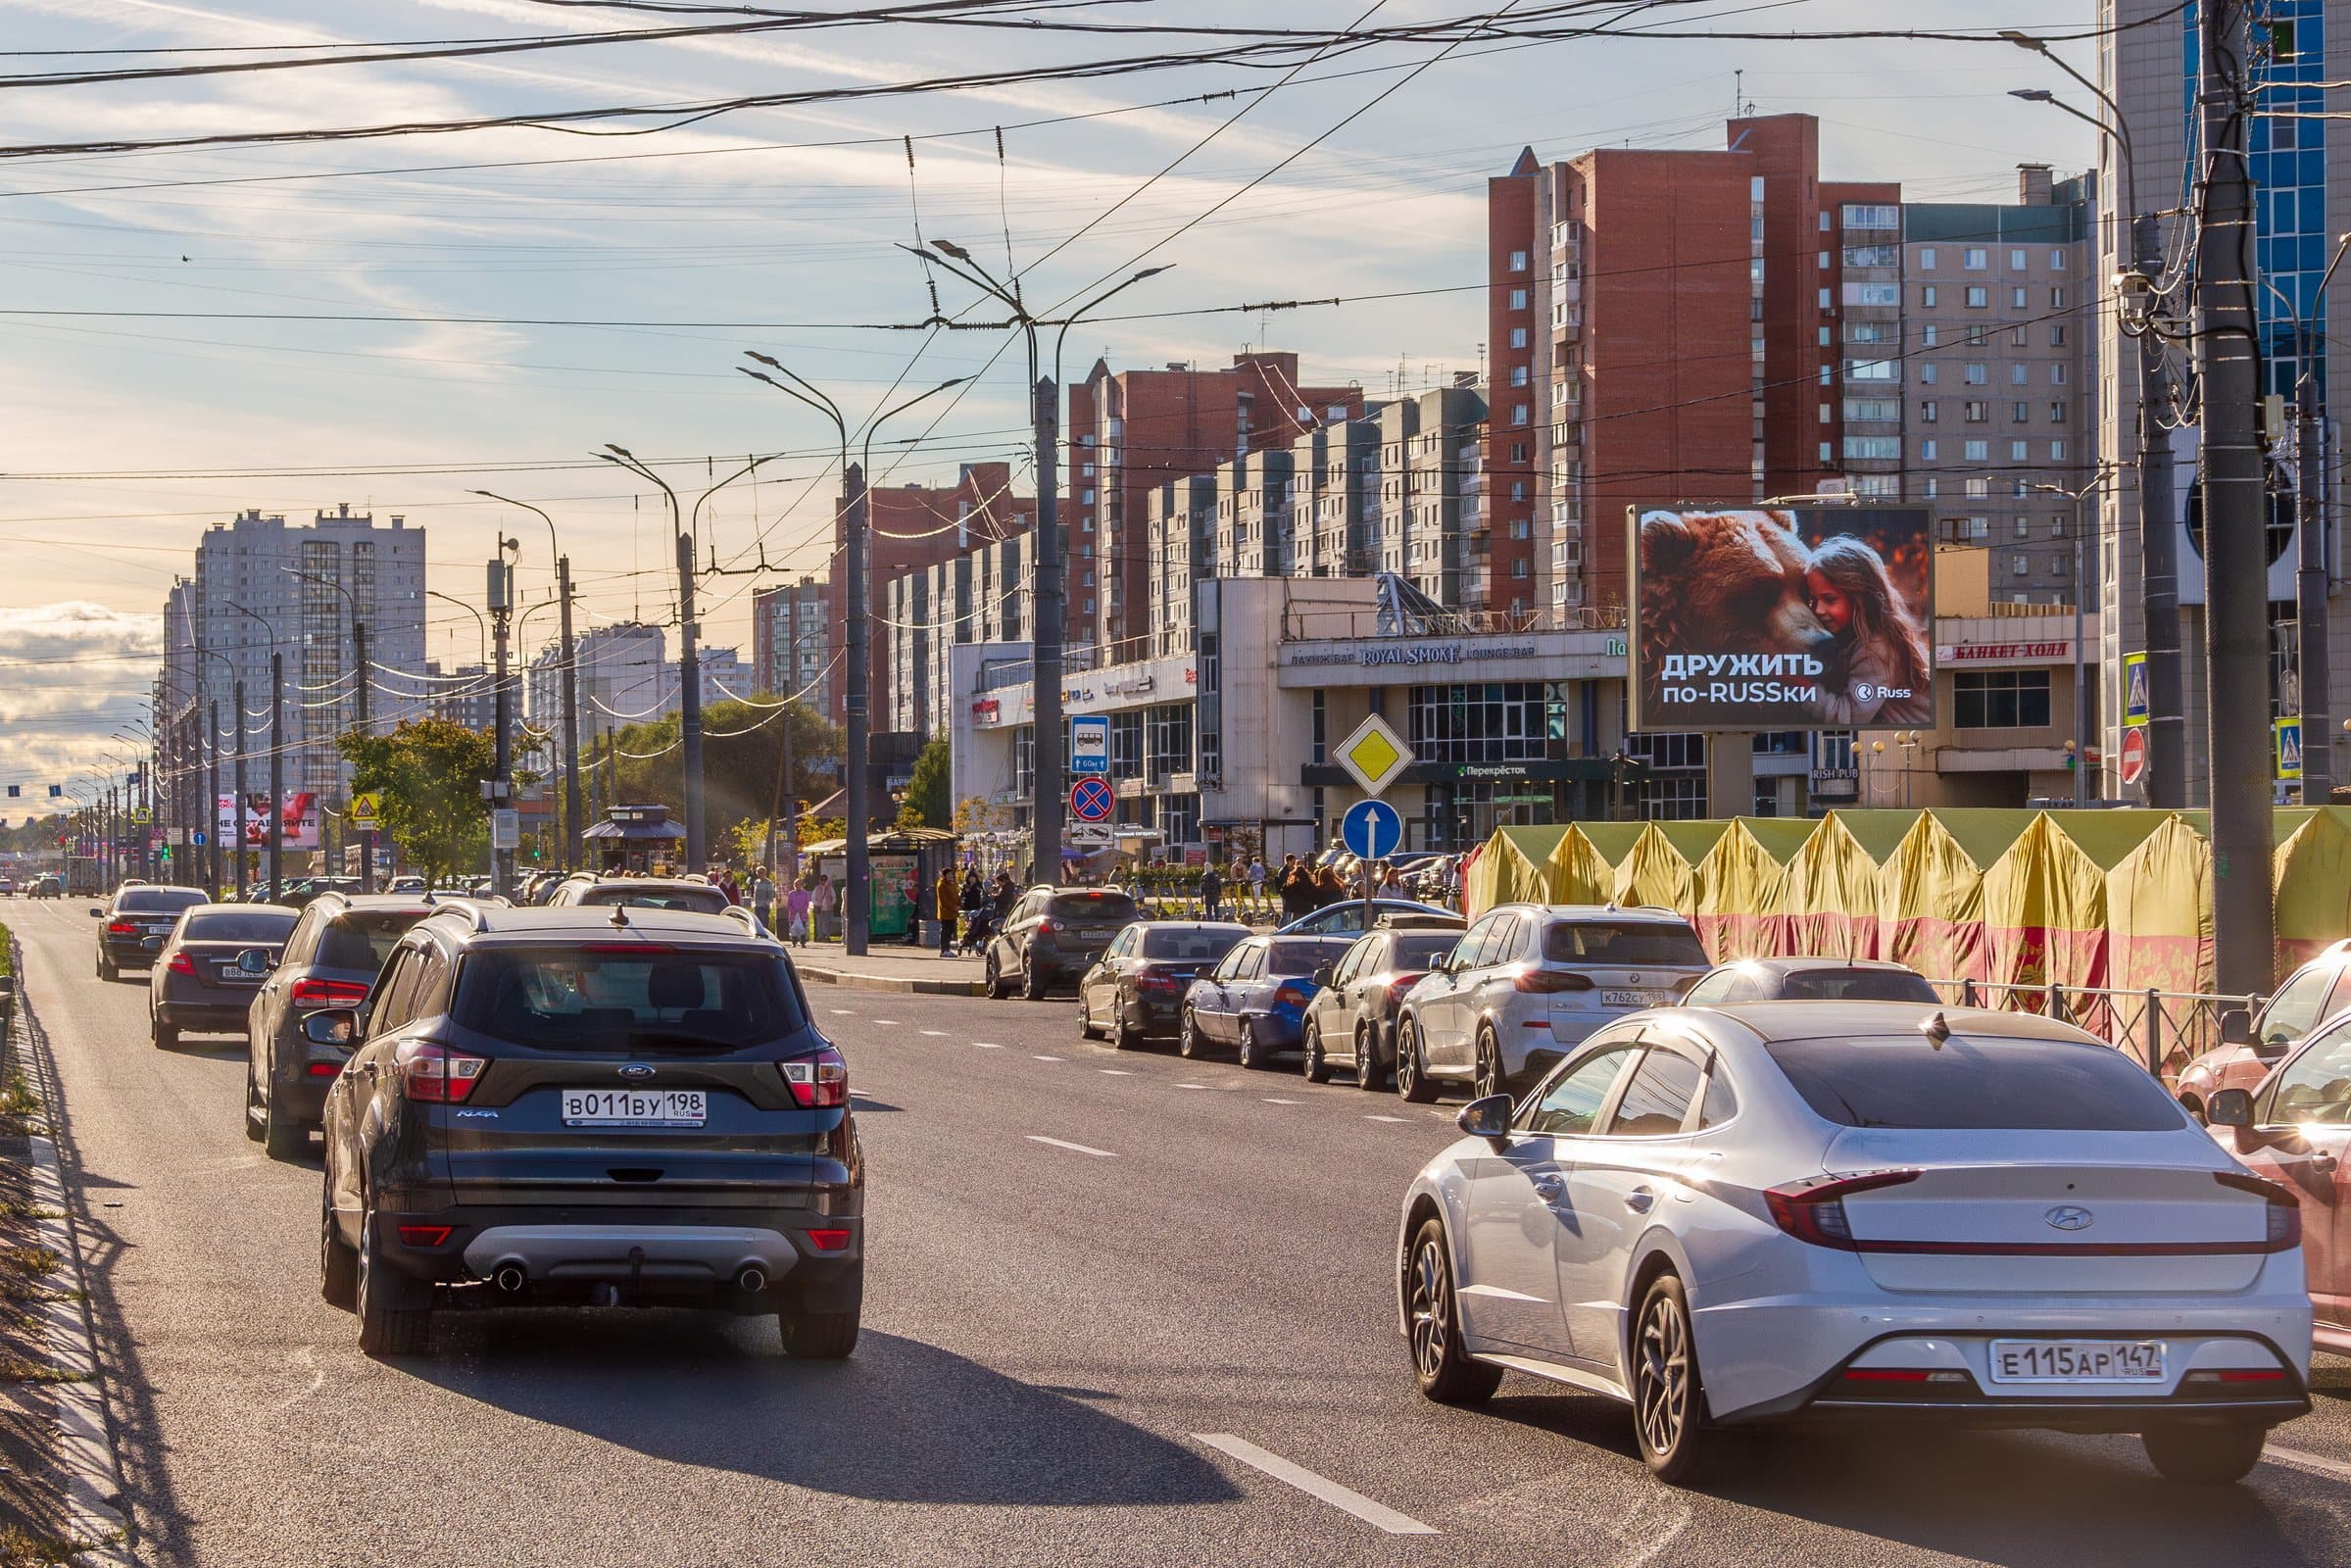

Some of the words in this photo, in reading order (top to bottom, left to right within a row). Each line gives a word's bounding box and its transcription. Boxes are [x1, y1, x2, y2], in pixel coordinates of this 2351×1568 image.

[1361, 646, 1404, 666] ROYAL
[1406, 644, 1459, 665] SMOKE
[1955, 642, 2069, 660] БАНКЕТ-ХОЛЛ
[1661, 654, 1824, 681] ДРУЖИТЬ
[1663, 682, 1817, 704] по-RUSSки
[1877, 686, 1911, 699] Russ
[1466, 765, 1527, 777] Перекрёсток
[1810, 769, 1836, 779] IRISH
[1838, 768, 1859, 778] PUB
[457, 1109, 499, 1118] KUGA
[570, 1094, 661, 1116] В011ВУ
[666, 1093, 700, 1110] 198
[2002, 1347, 2109, 1376] Е115АР
[2117, 1346, 2156, 1368] 147
